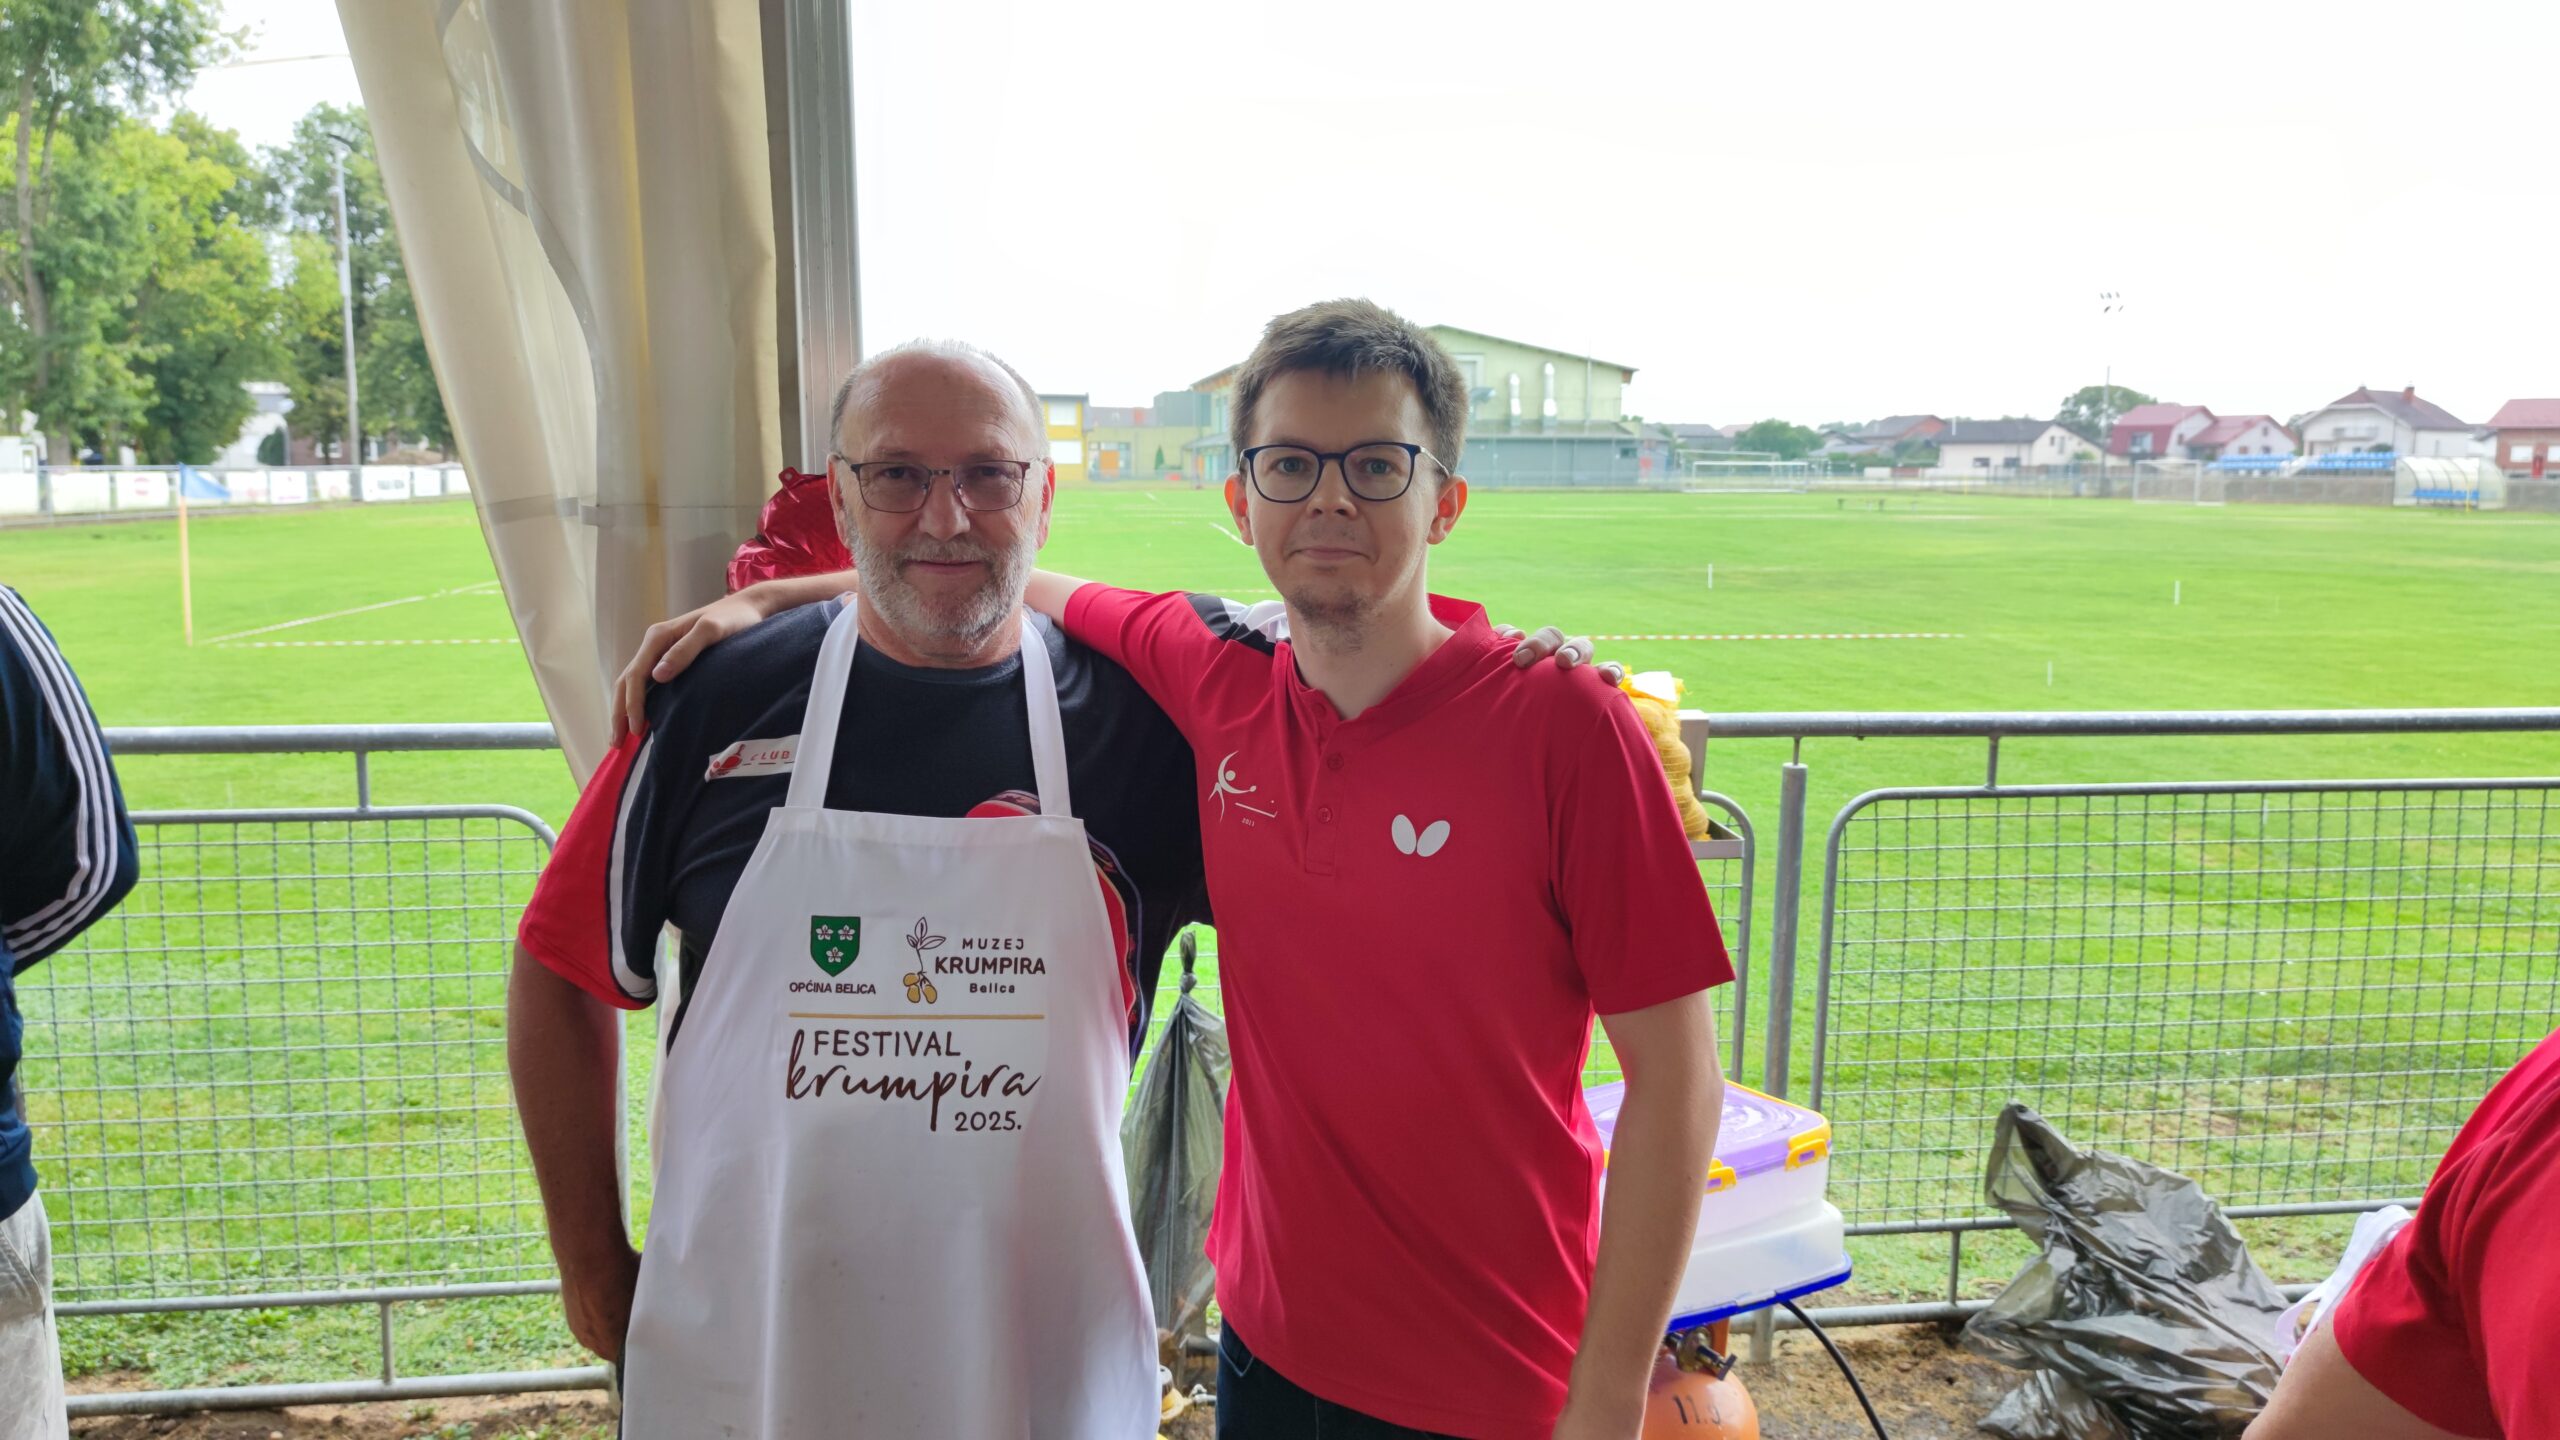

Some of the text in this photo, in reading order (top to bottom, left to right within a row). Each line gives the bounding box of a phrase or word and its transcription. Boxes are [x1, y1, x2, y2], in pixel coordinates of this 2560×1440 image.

[962, 938, 1025, 950] MUZEJ
[935, 956, 1046, 975] KRUMPIRA
[789, 979, 877, 995] OPĆINA BELICA
[969, 982, 1015, 994] Belica
[813, 1030, 961, 1057] FESTIVAL
[786, 1028, 1042, 1132] krumpira
[954, 1110, 1022, 1132] 2025.
